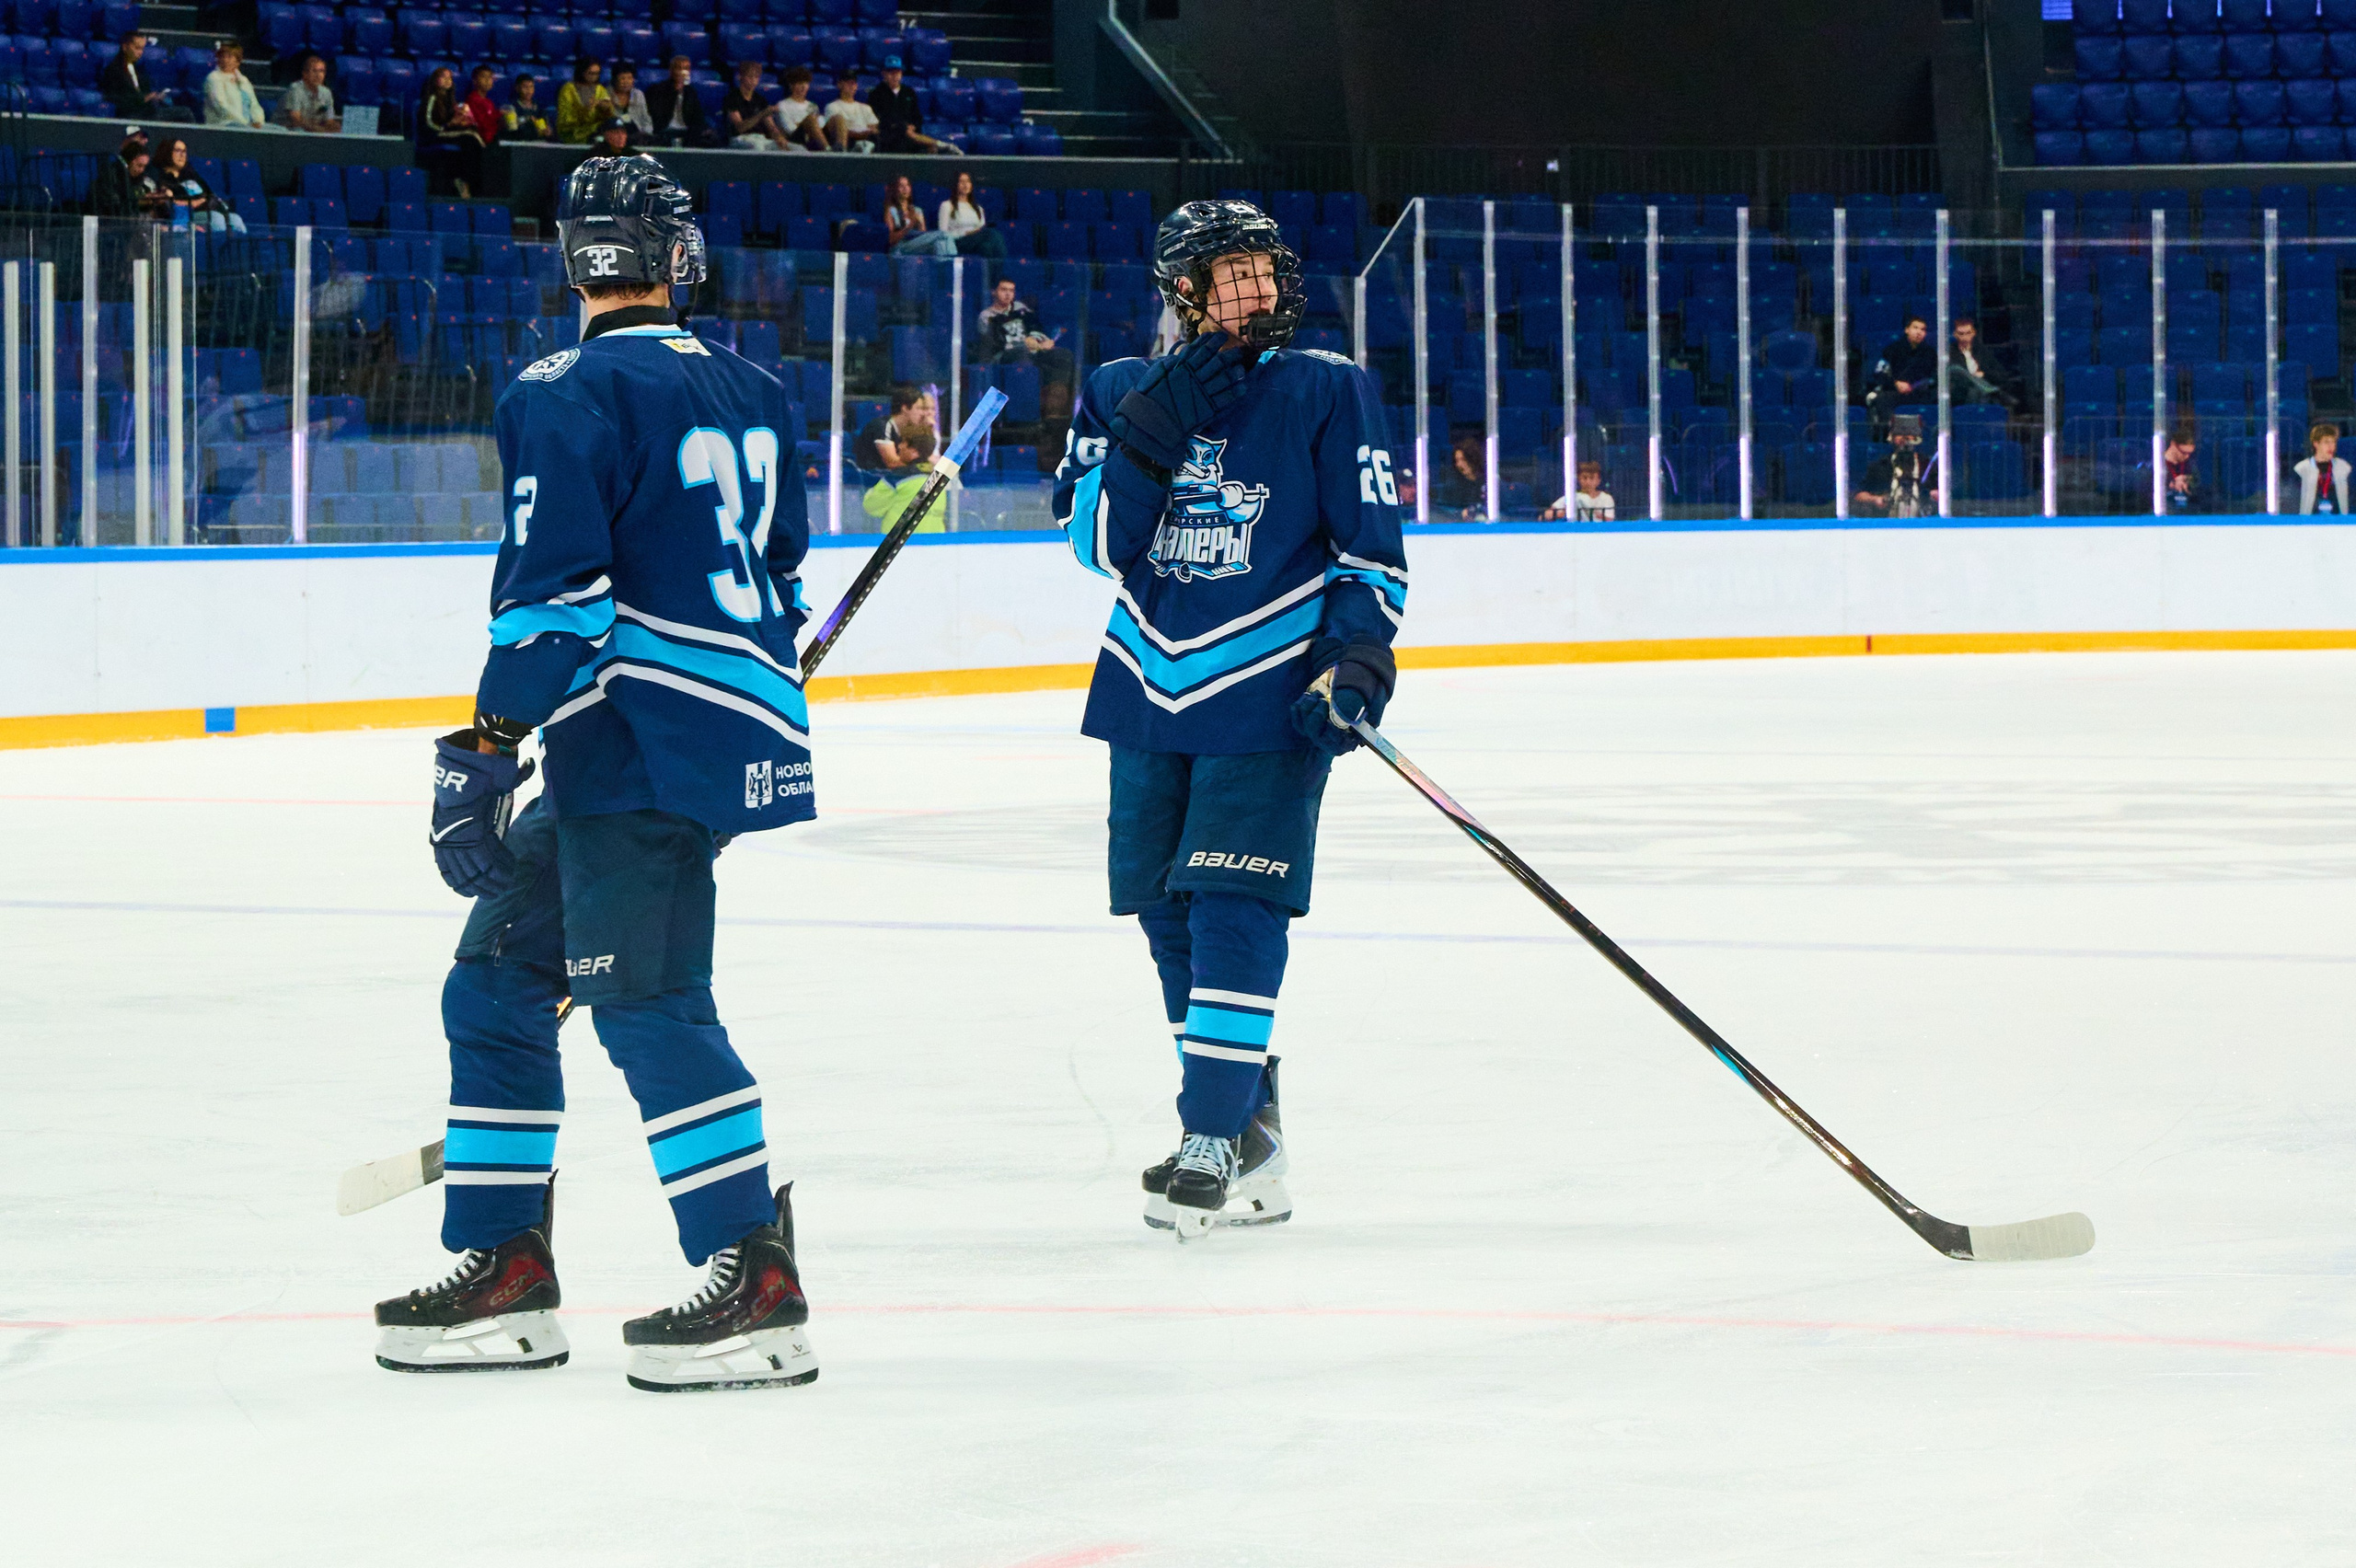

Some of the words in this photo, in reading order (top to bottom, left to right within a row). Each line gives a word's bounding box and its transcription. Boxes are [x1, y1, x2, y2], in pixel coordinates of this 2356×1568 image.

[587, 248, 618, 276] 32
[1357, 444, 1398, 506] 26
[500, 476, 537, 547] 2
[677, 426, 784, 623] 32
[1186, 851, 1290, 879] BAUER
[489, 1269, 534, 1307] CCM
[733, 1274, 786, 1332] CCM
